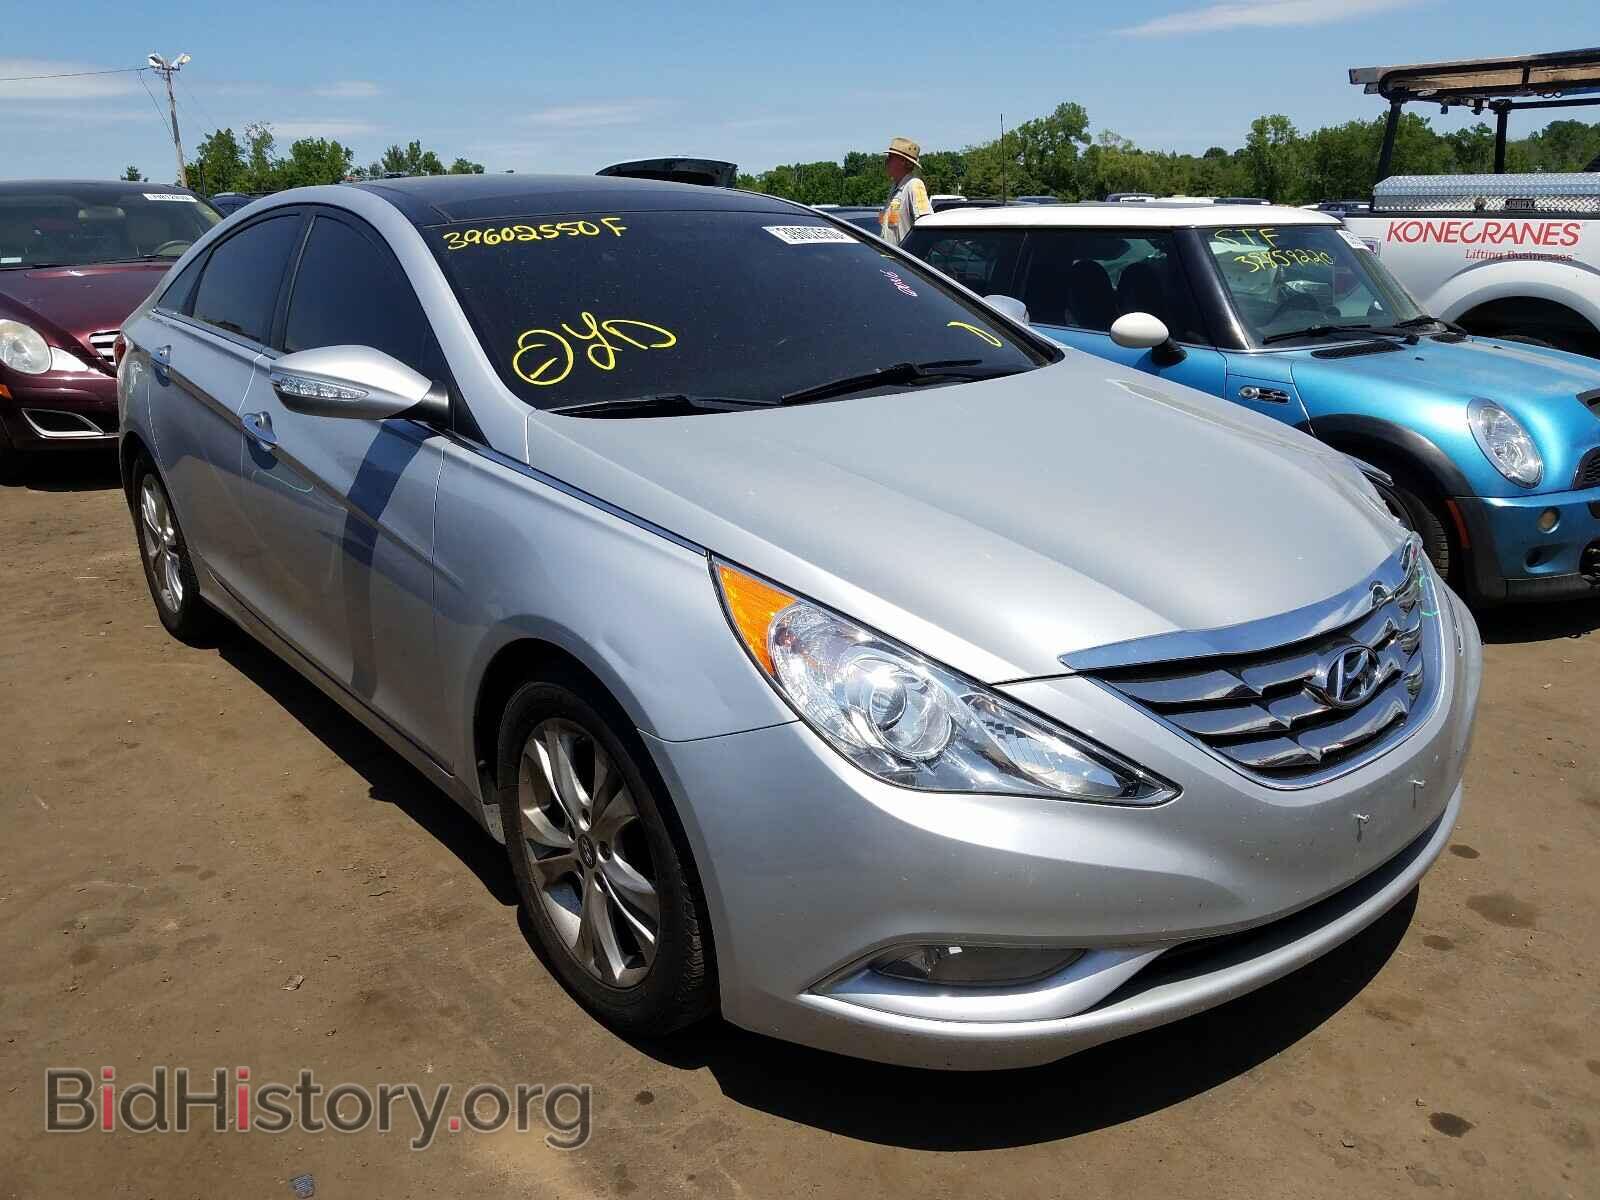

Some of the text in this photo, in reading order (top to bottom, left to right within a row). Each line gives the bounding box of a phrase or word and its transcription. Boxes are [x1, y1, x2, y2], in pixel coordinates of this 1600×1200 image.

[1386, 221, 1580, 246] KONECRANES
[1465, 248, 1573, 262] Lifting Businesses
